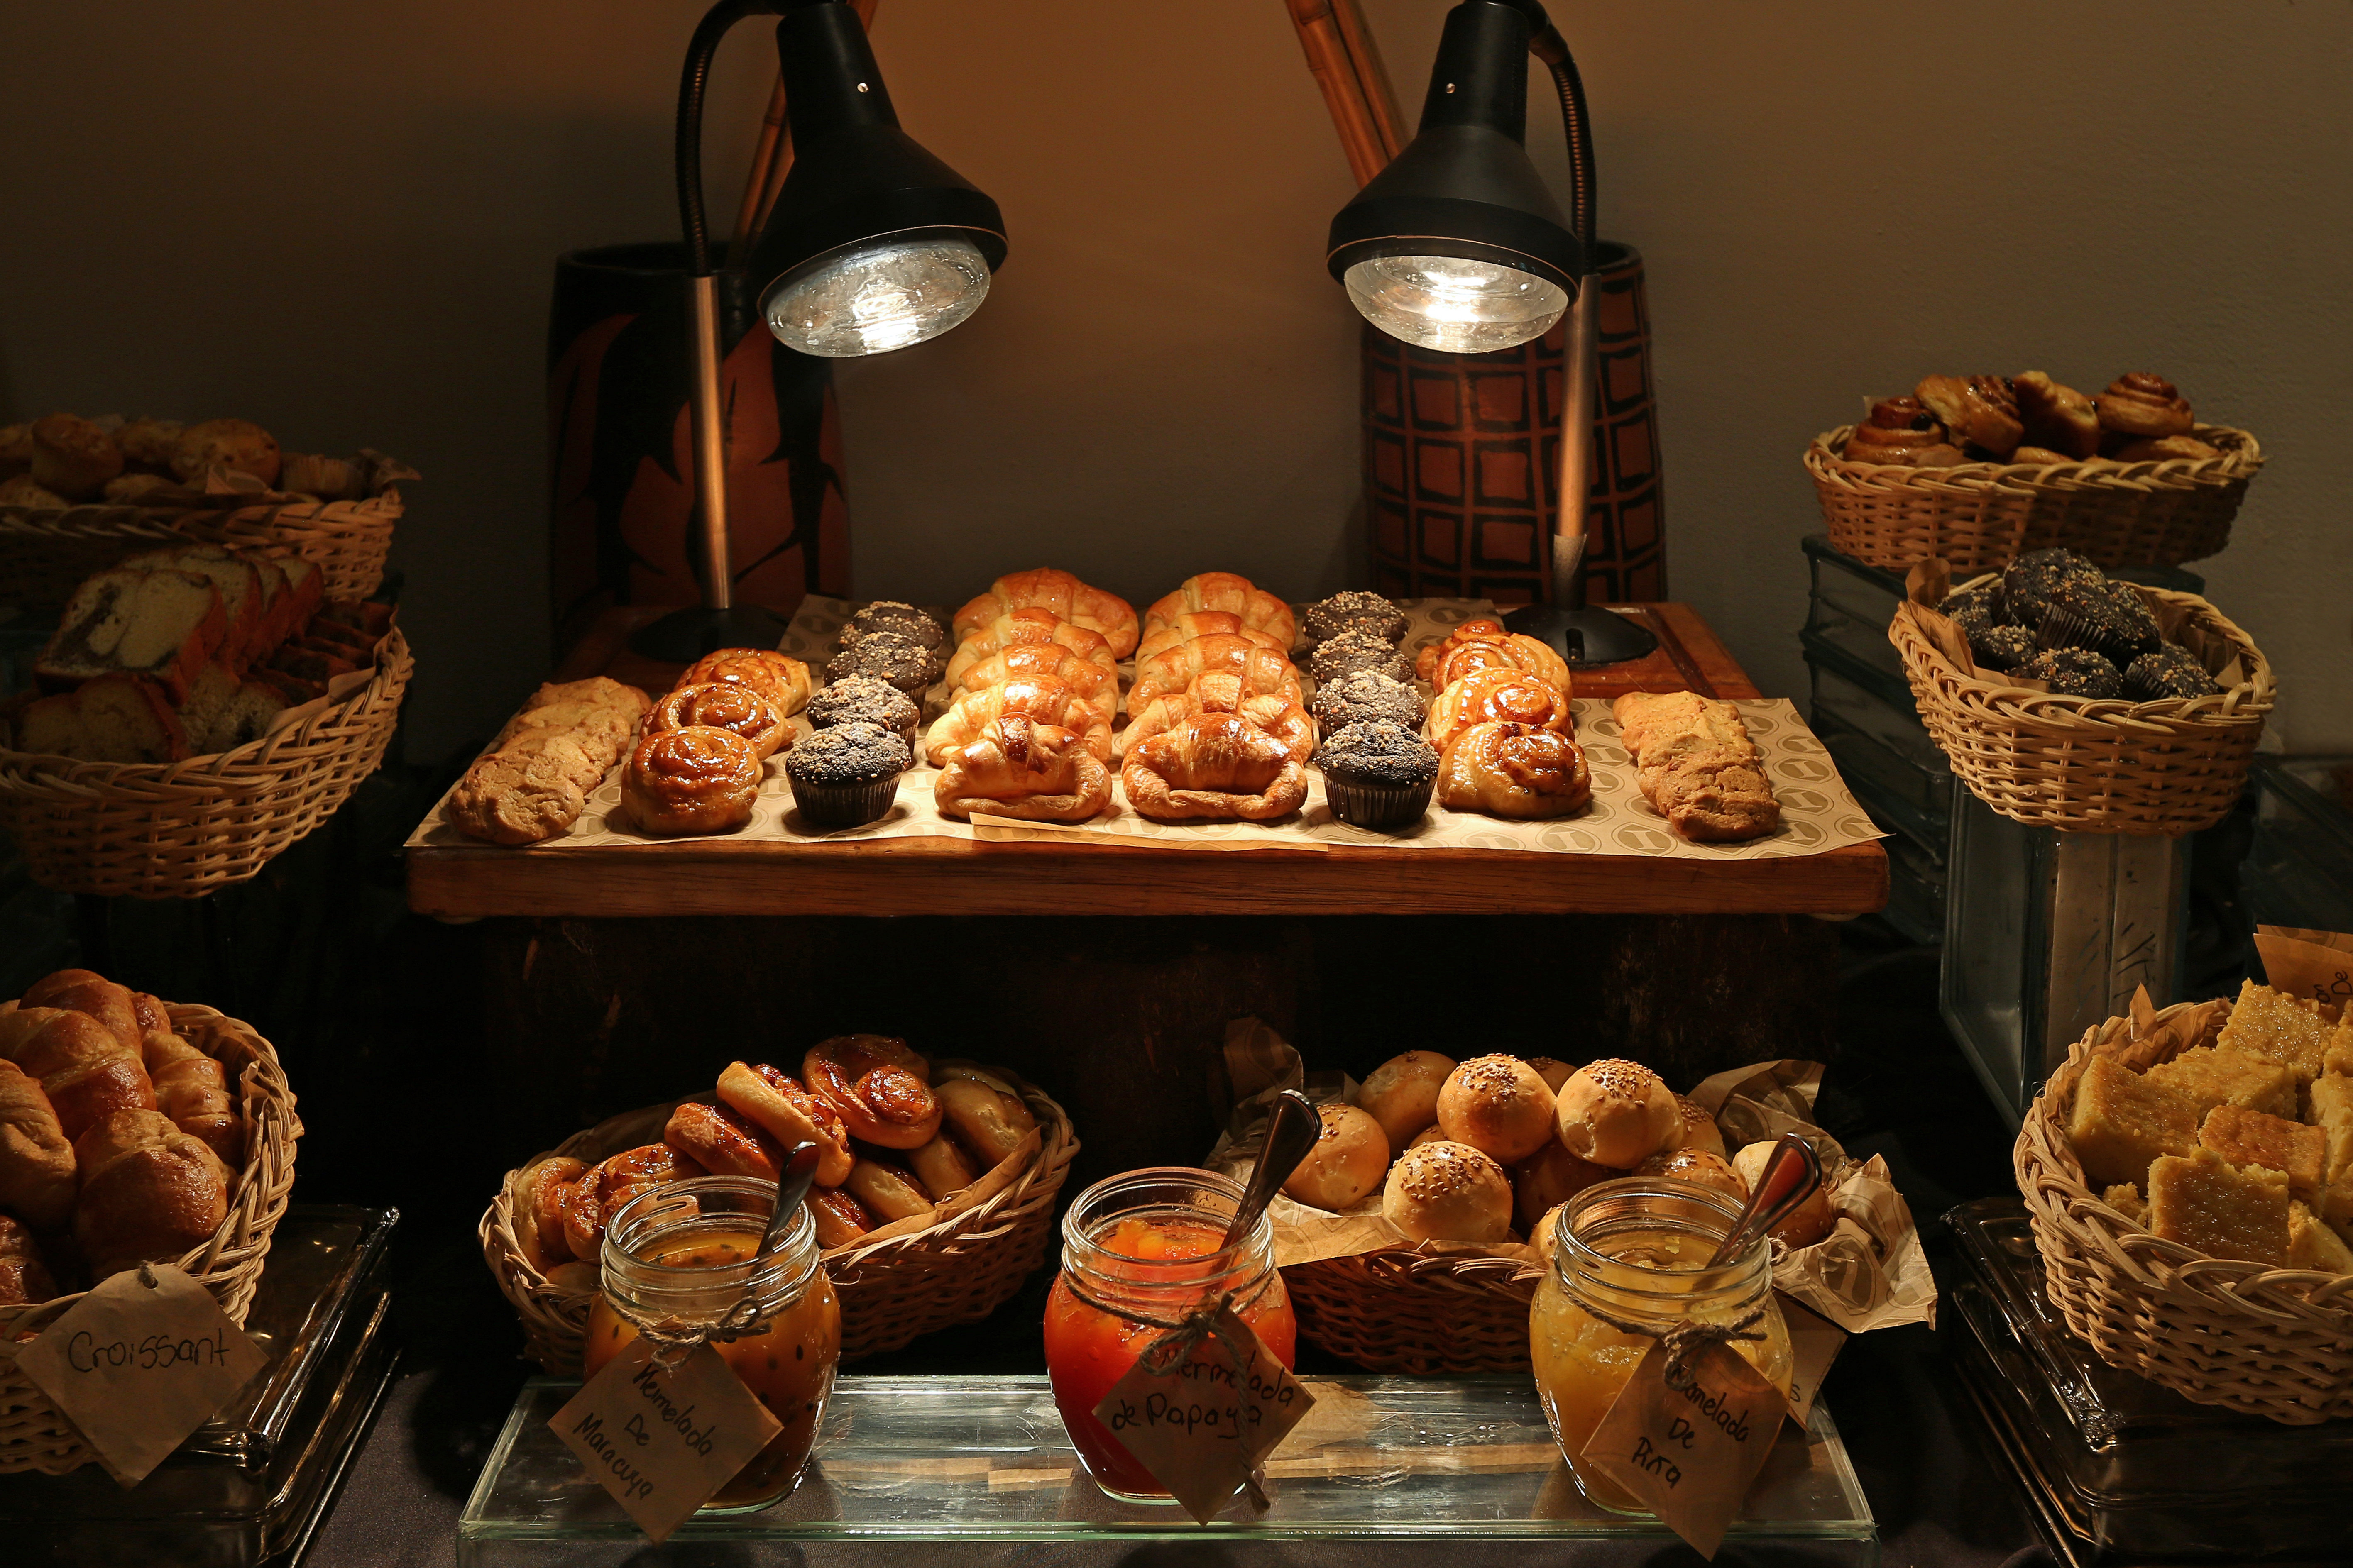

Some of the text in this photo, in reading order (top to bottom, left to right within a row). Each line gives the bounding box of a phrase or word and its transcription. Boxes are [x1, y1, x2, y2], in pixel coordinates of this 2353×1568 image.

[68, 1328, 230, 1373] Croissant
[624, 1413, 651, 1446] De
[1111, 1392, 1263, 1439] de Papaya
[1668, 1417, 1695, 1449] De
[572, 1412, 654, 1500] Maracuya
